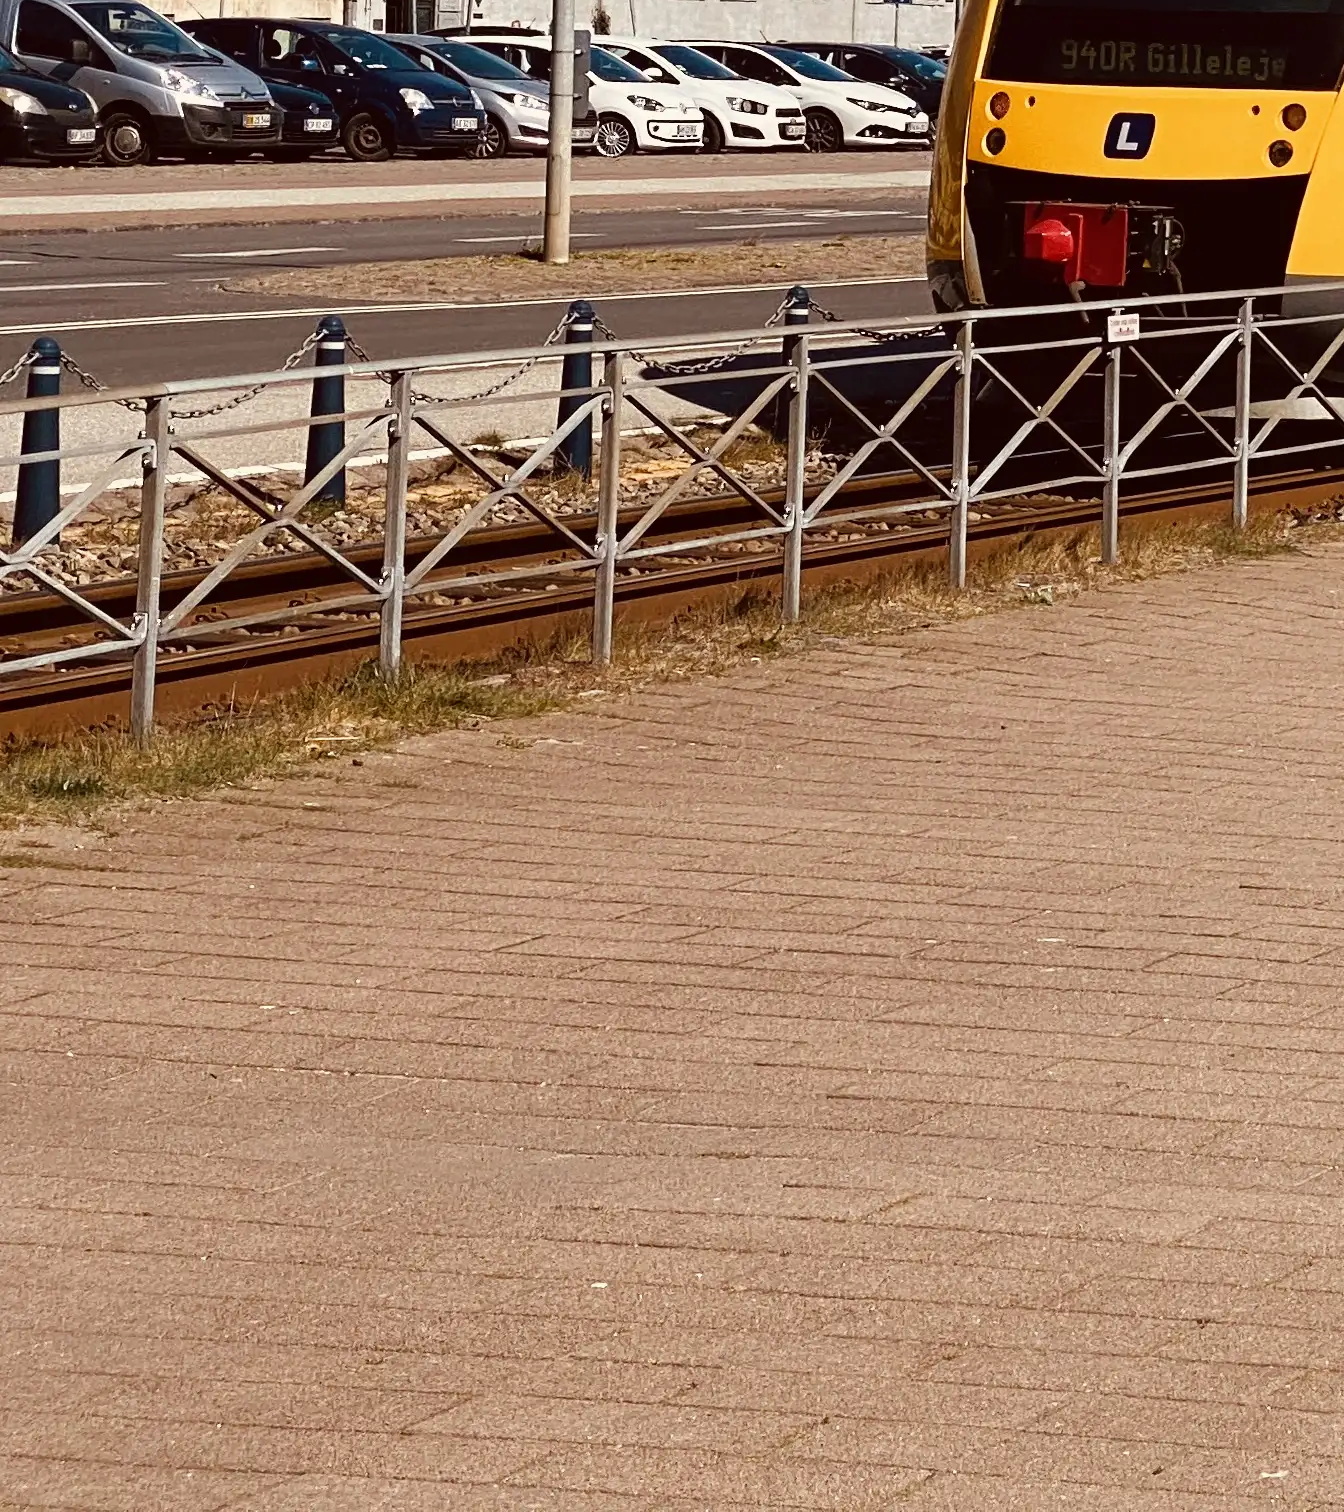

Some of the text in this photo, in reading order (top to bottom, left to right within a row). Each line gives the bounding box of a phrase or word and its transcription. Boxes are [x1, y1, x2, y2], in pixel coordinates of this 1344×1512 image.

[1060, 38, 1288, 82] 940R Gilleleje
[1115, 121, 1139, 151] L
